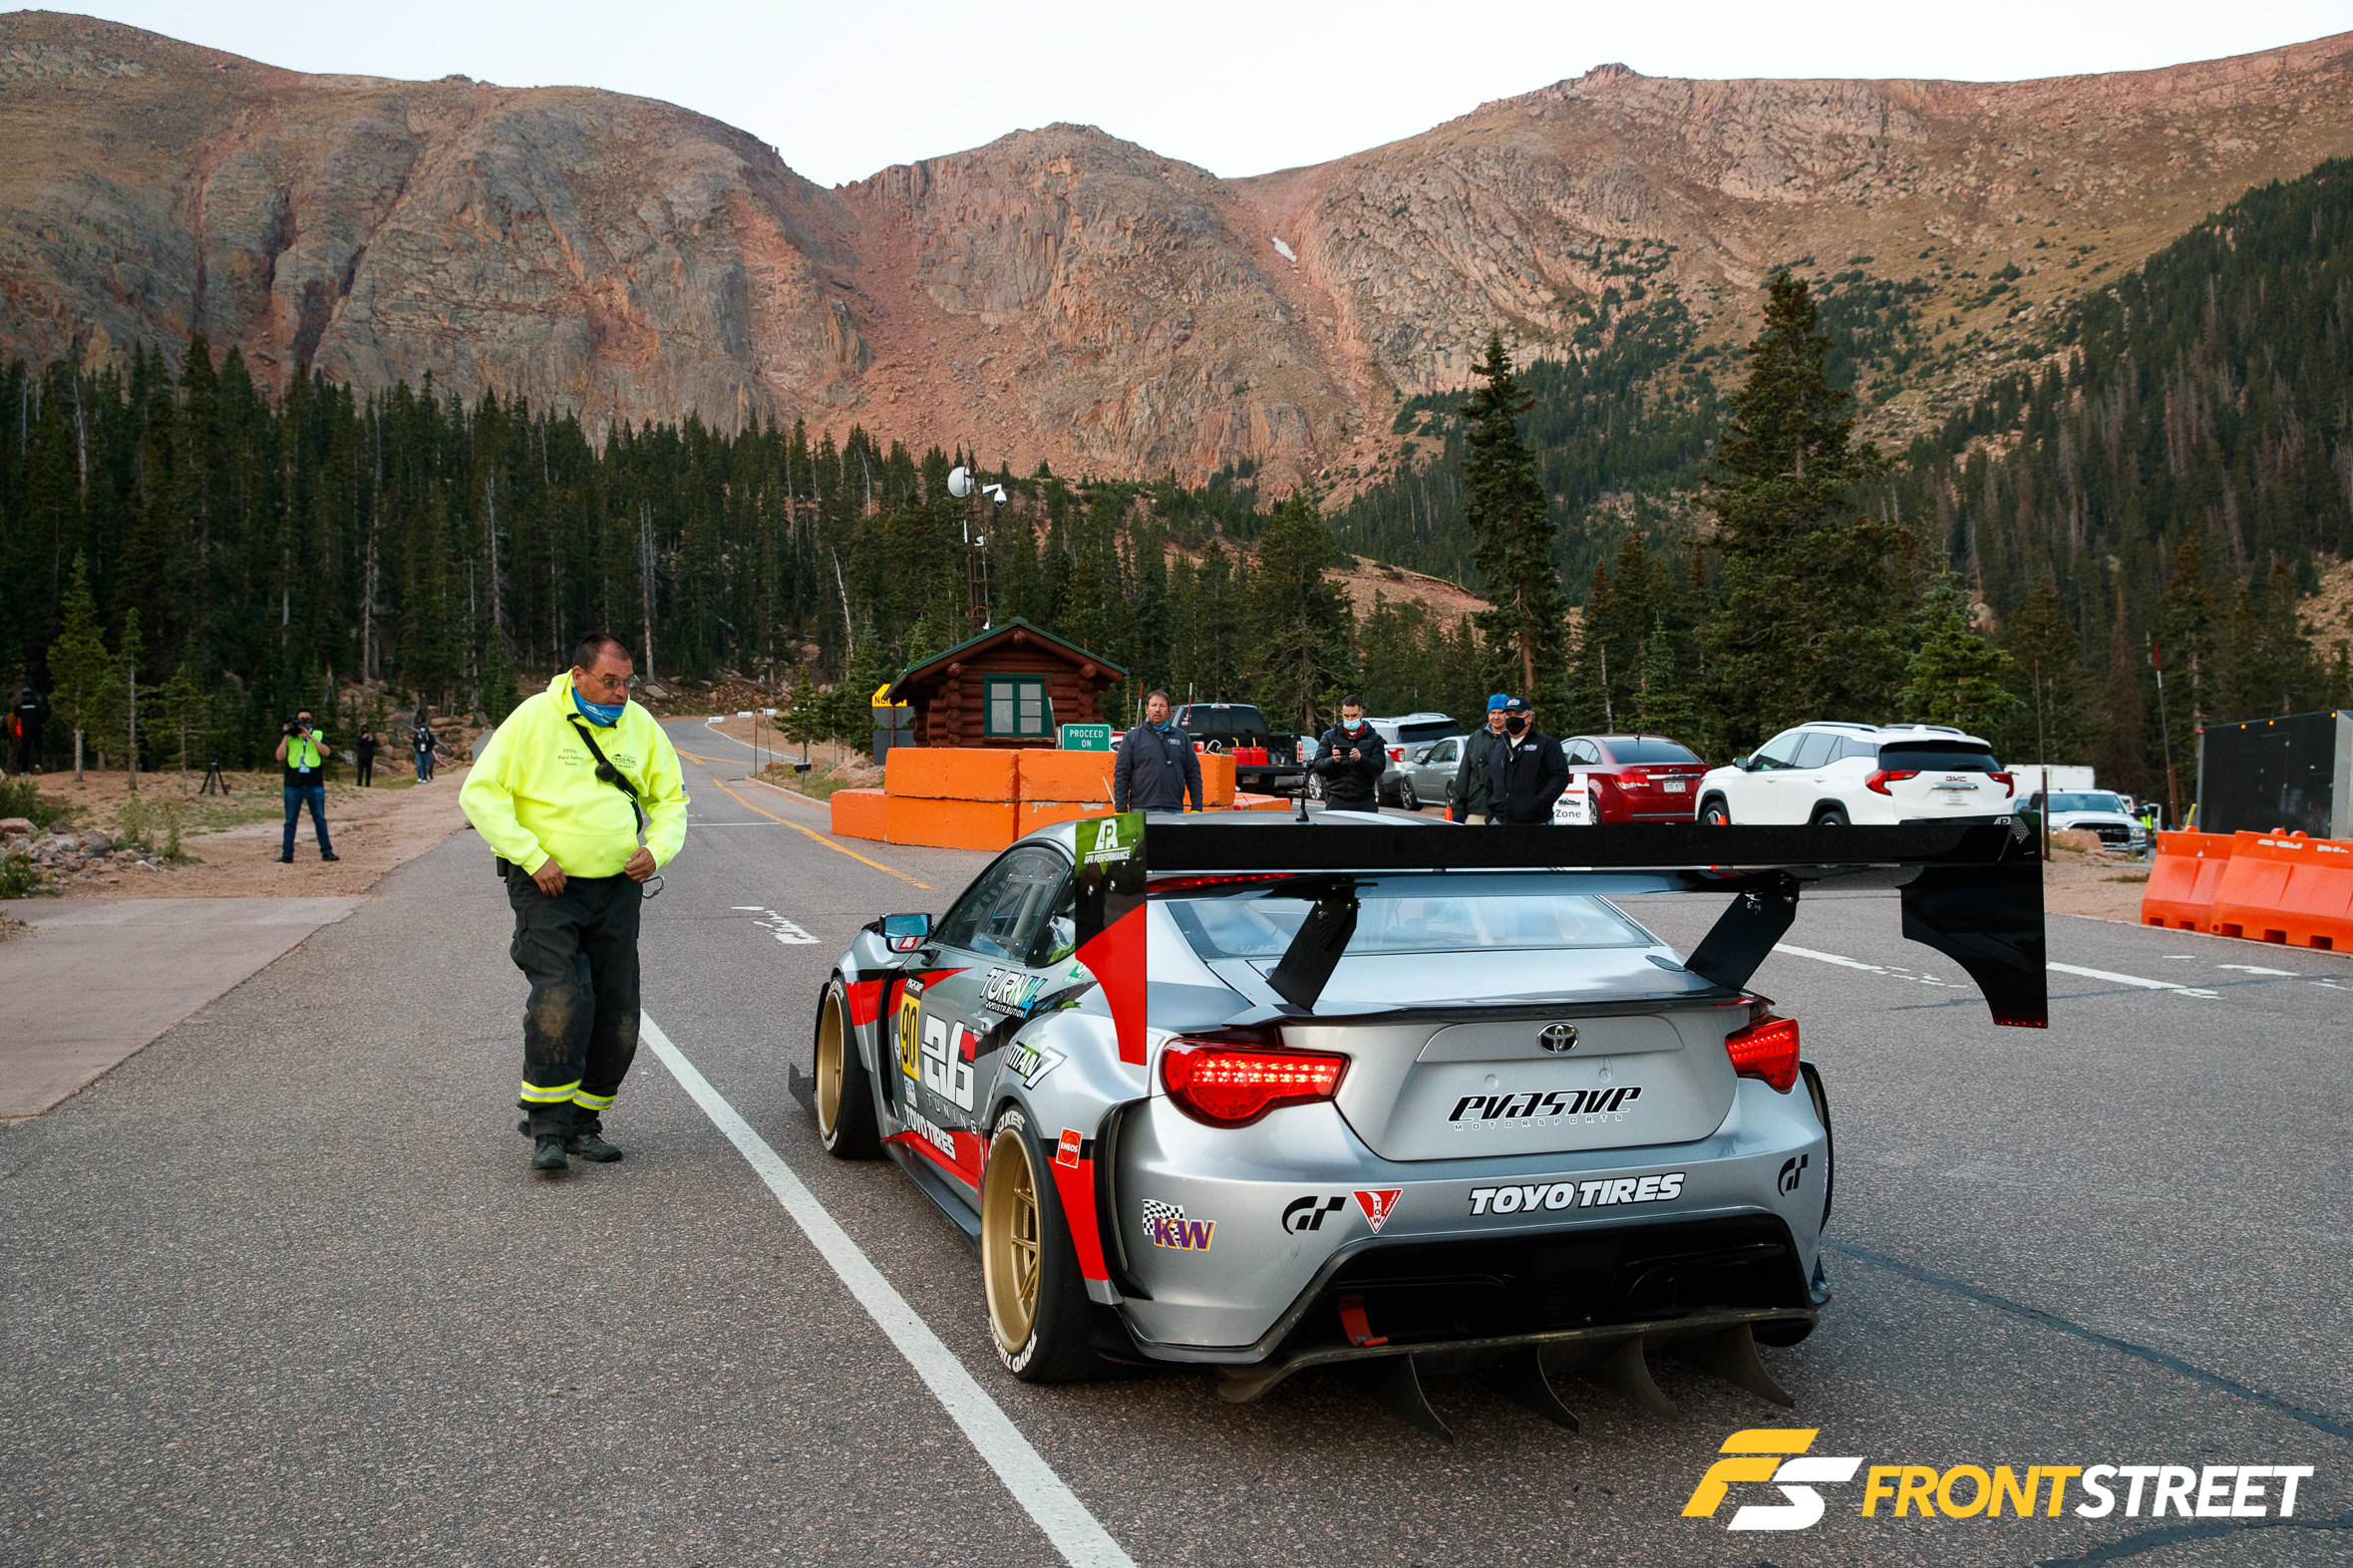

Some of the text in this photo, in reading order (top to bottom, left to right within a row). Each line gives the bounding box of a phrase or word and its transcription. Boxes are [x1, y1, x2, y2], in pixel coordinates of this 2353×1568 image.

[1069, 729, 1104, 739] PROCEED
[1081, 739, 1092, 748] ON
[1555, 808, 1581, 818] Zone
[901, 1002, 918, 1070] 90
[926, 1092, 977, 1135] TUNING
[1454, 1113, 1623, 1131] MOTORSPORTS
[904, 1102, 956, 1161] TOYO TIRES
[1060, 1141, 1079, 1153] ENEOS
[1469, 1172, 1686, 1216] TOYO TIRES
[1154, 1216, 1216, 1251] KW
